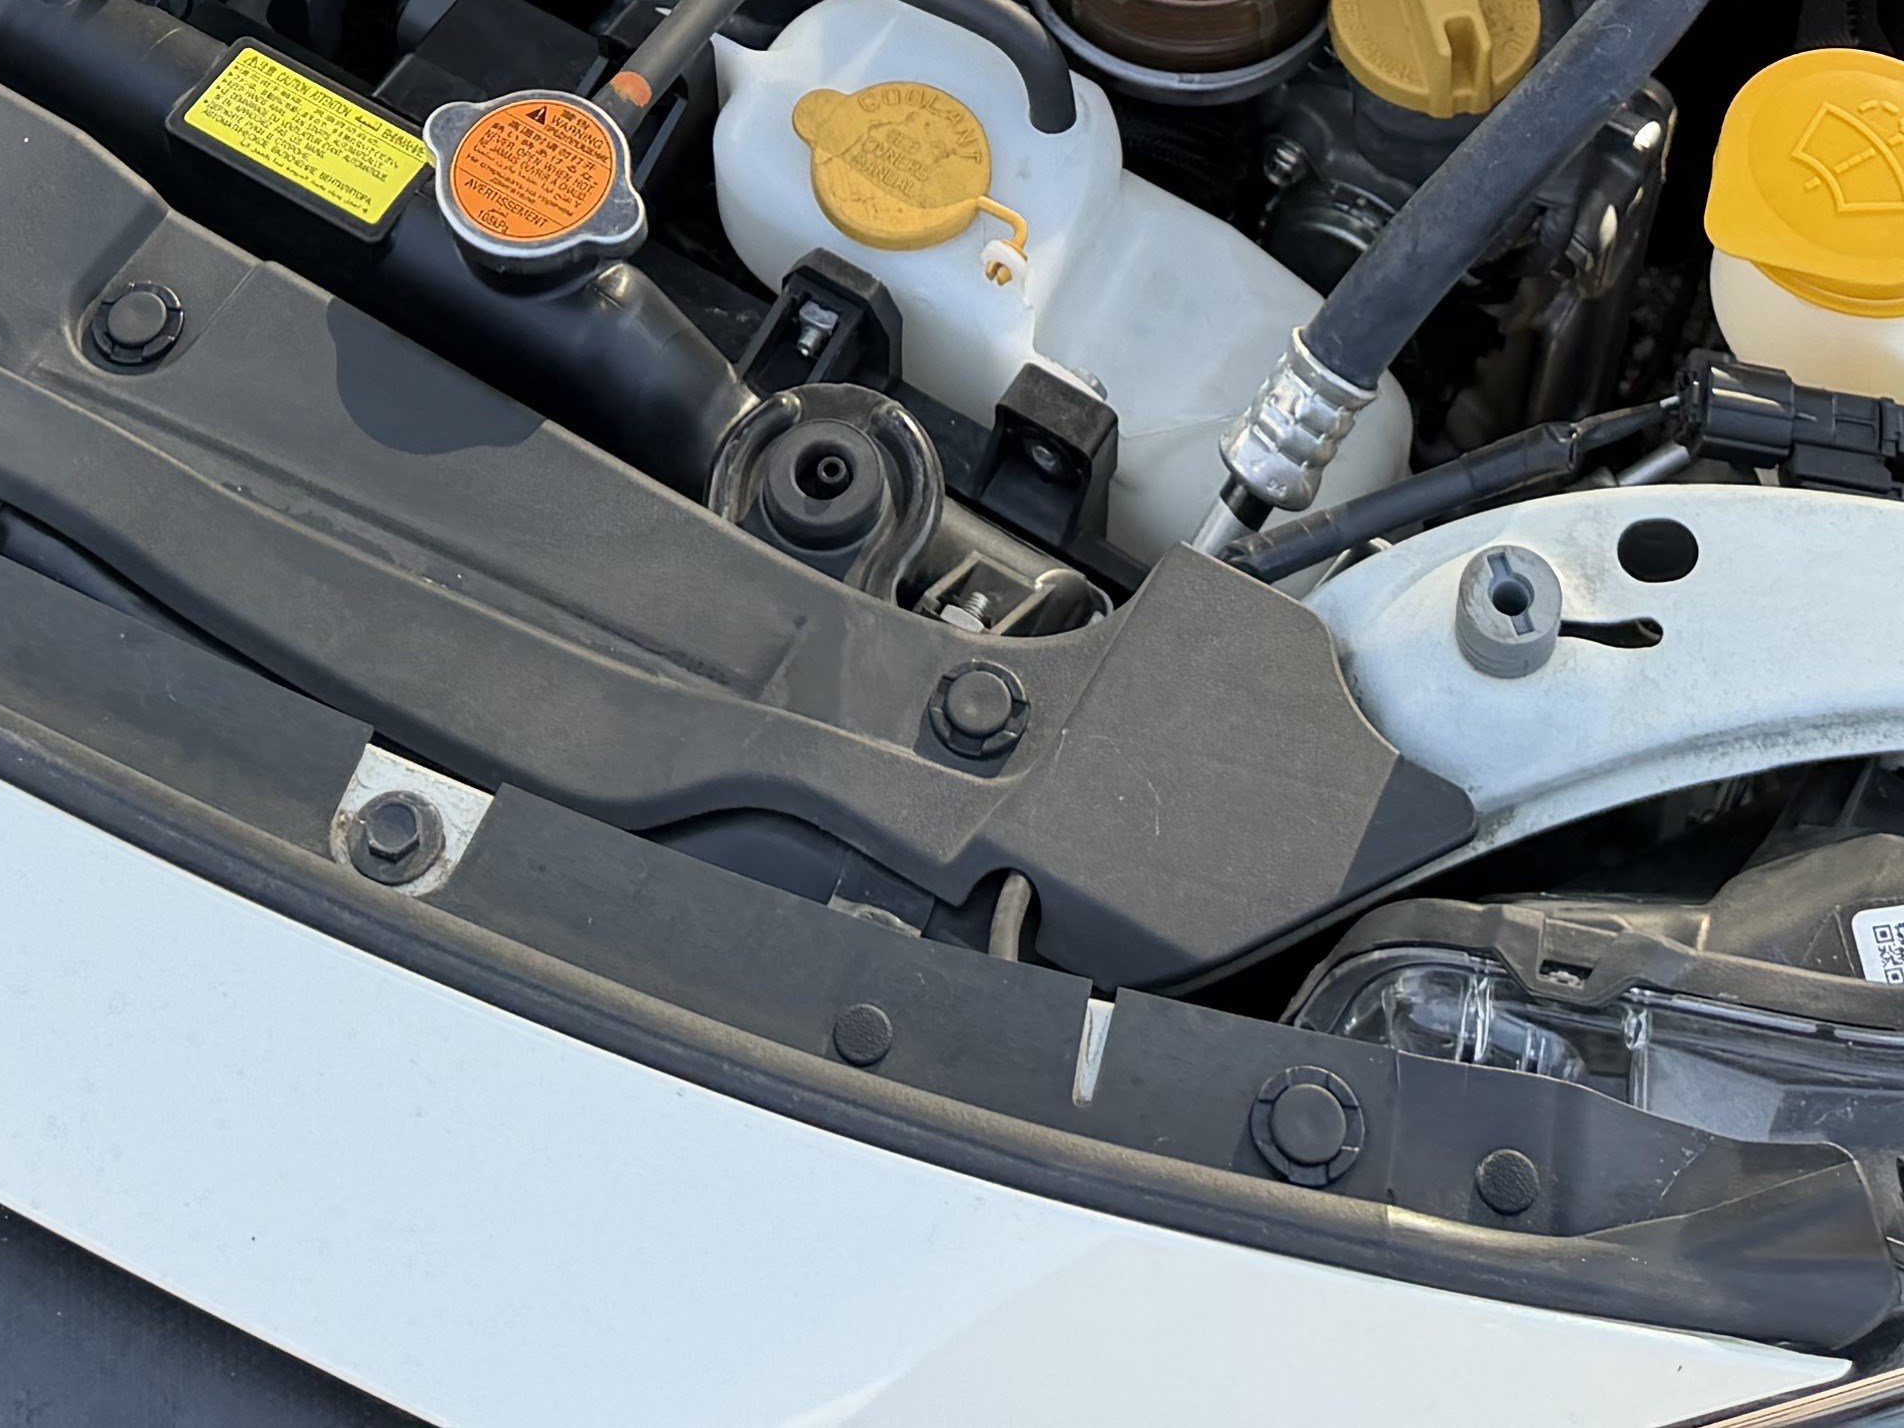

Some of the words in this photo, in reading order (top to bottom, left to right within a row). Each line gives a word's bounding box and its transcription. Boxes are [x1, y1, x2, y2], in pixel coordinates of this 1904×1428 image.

[275, 70, 312, 95] CAUTION
[308, 88, 353, 118] ATTENTION
[549, 113, 604, 150] WARNING
[857, 86, 986, 166] COOLANT
[483, 126, 516, 151] NEVER
[515, 145, 544, 167] OPEN
[541, 160, 573, 184] WHEN
[463, 175, 548, 230] AVERTISSEMENT
